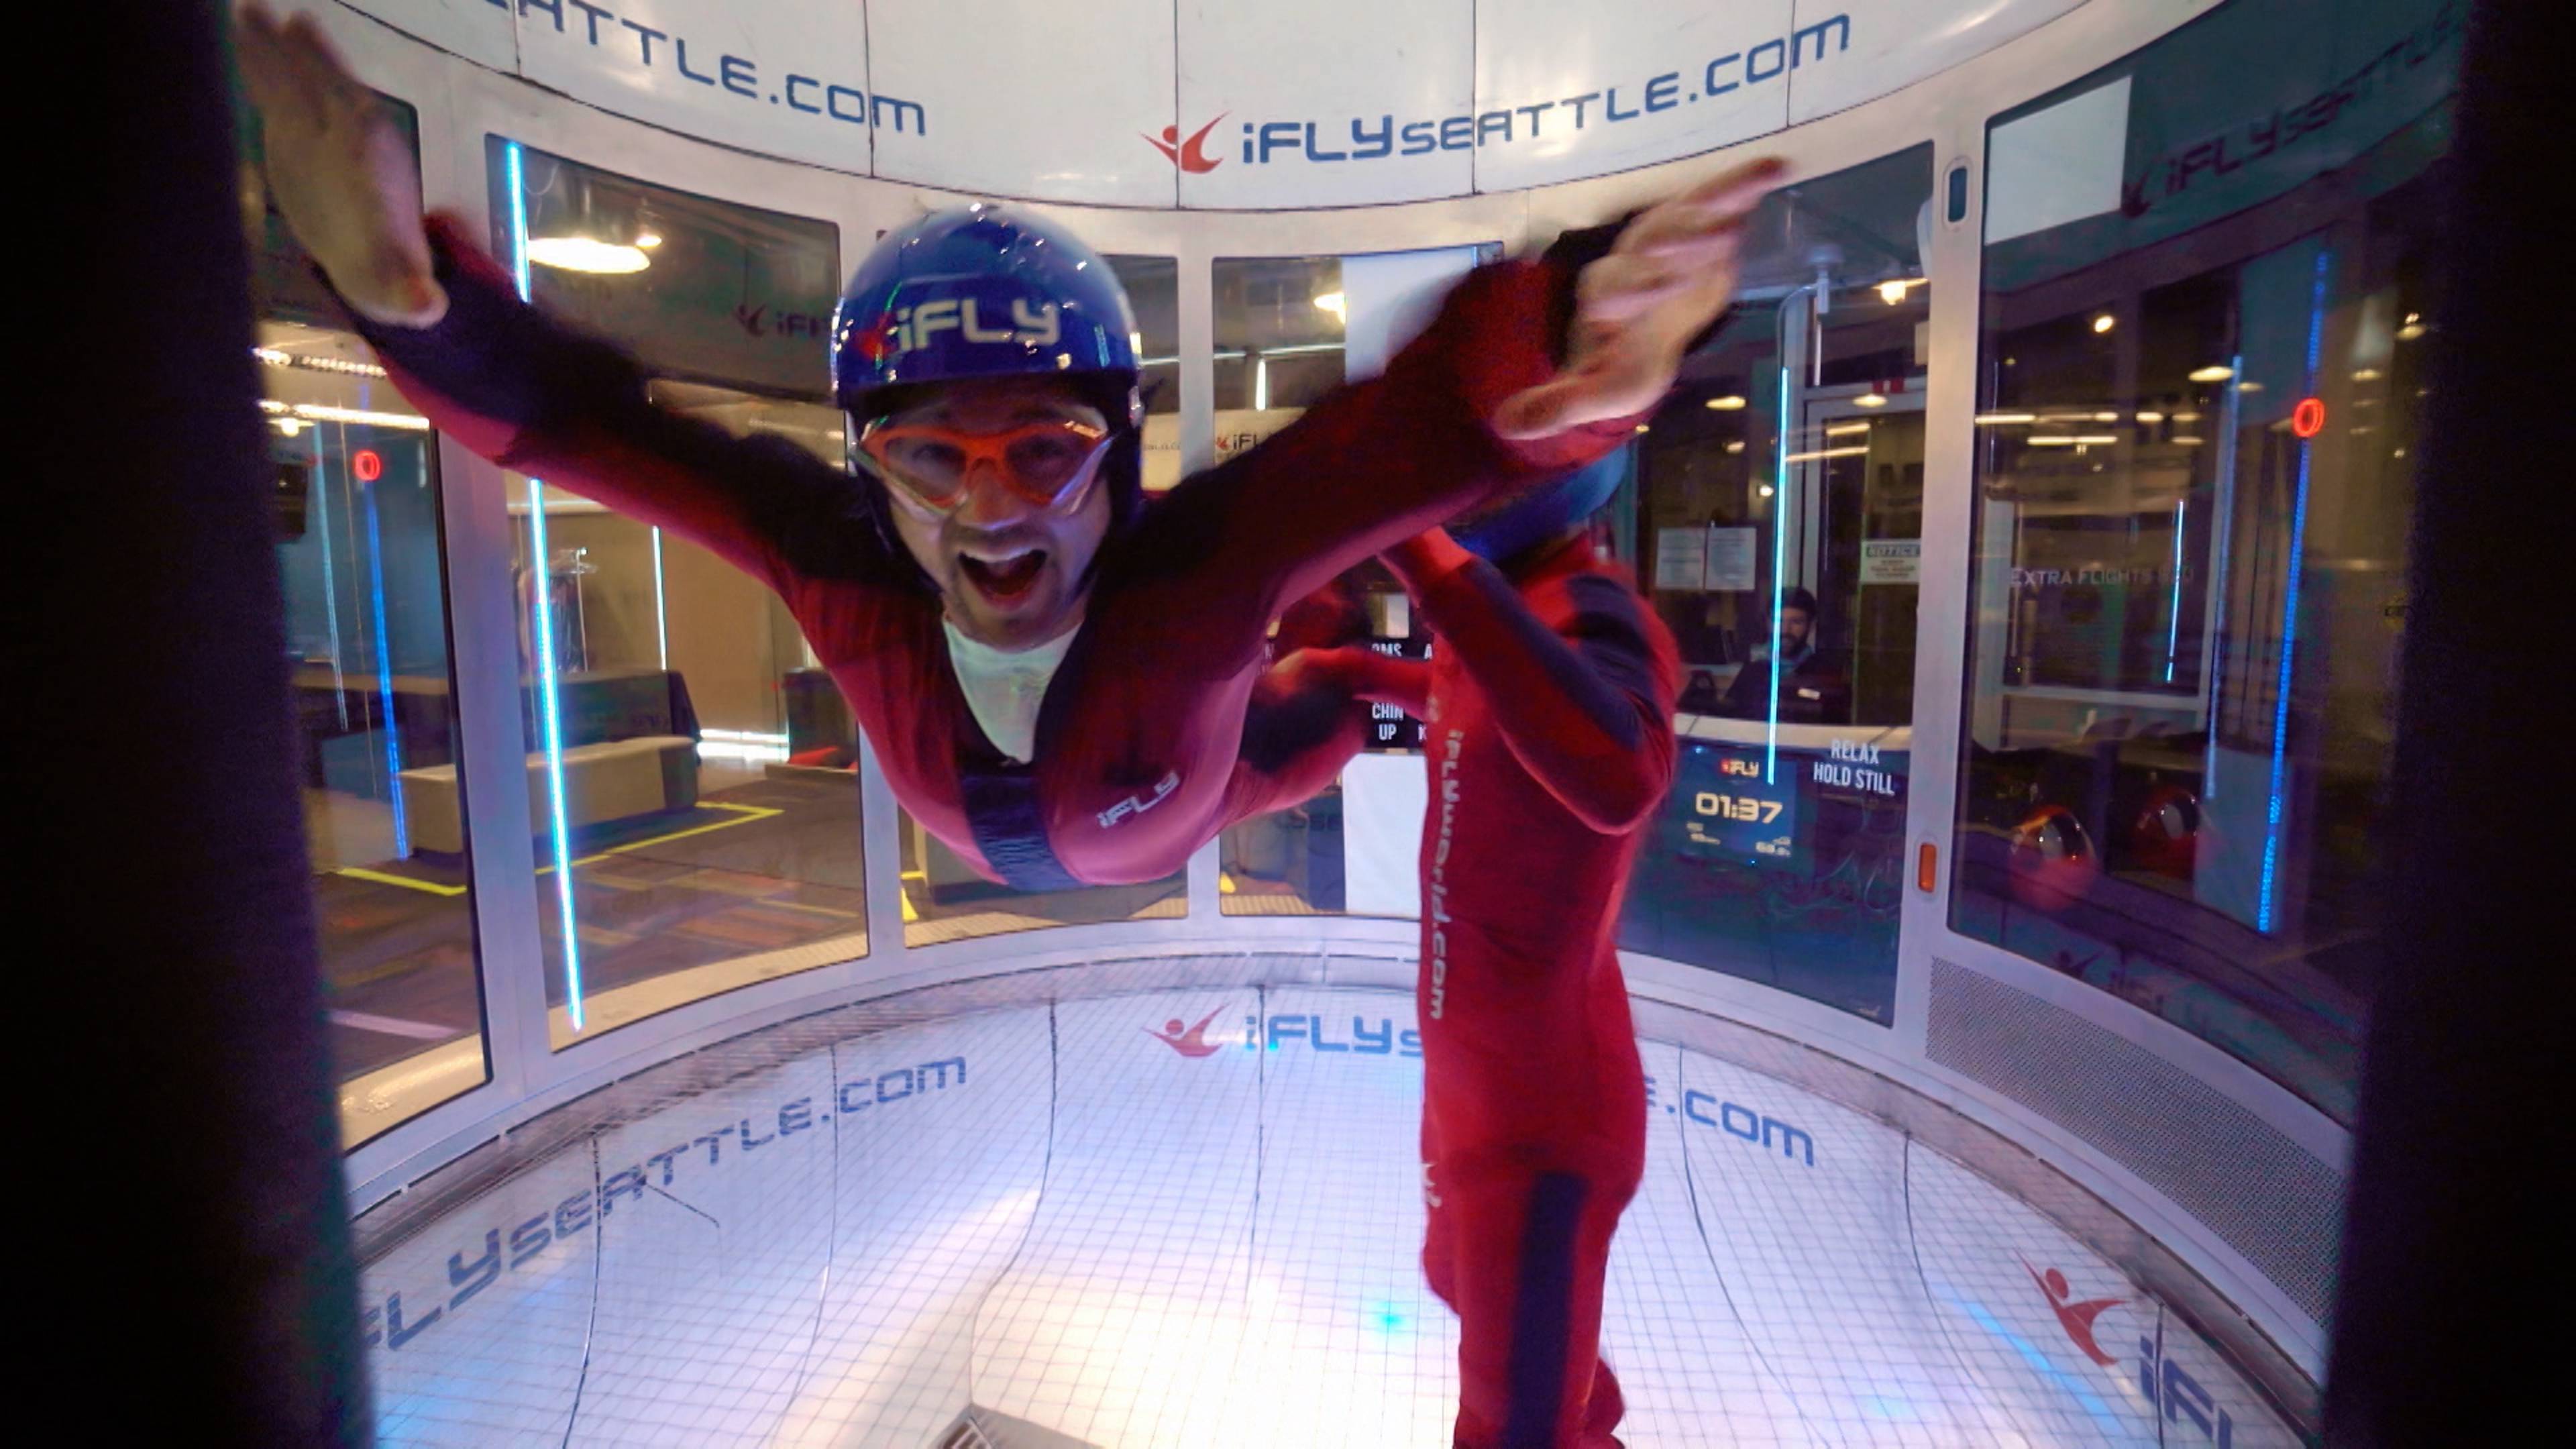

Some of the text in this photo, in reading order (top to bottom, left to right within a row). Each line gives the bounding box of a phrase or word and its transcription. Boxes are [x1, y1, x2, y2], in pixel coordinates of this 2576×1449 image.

[484, 0, 926, 136] ATTLE.COM
[897, 298, 1061, 352] iFLY
[2010, 568, 2072, 586] EXTRA
[1372, 703, 1404, 720] CHIN
[1379, 723, 1397, 741] UP
[1831, 740, 1880, 765] RELAX
[1813, 761, 1896, 796] HOLD STILL
[1095, 769, 1180, 829] iFLY
[1695, 792, 1783, 824] 01:37
